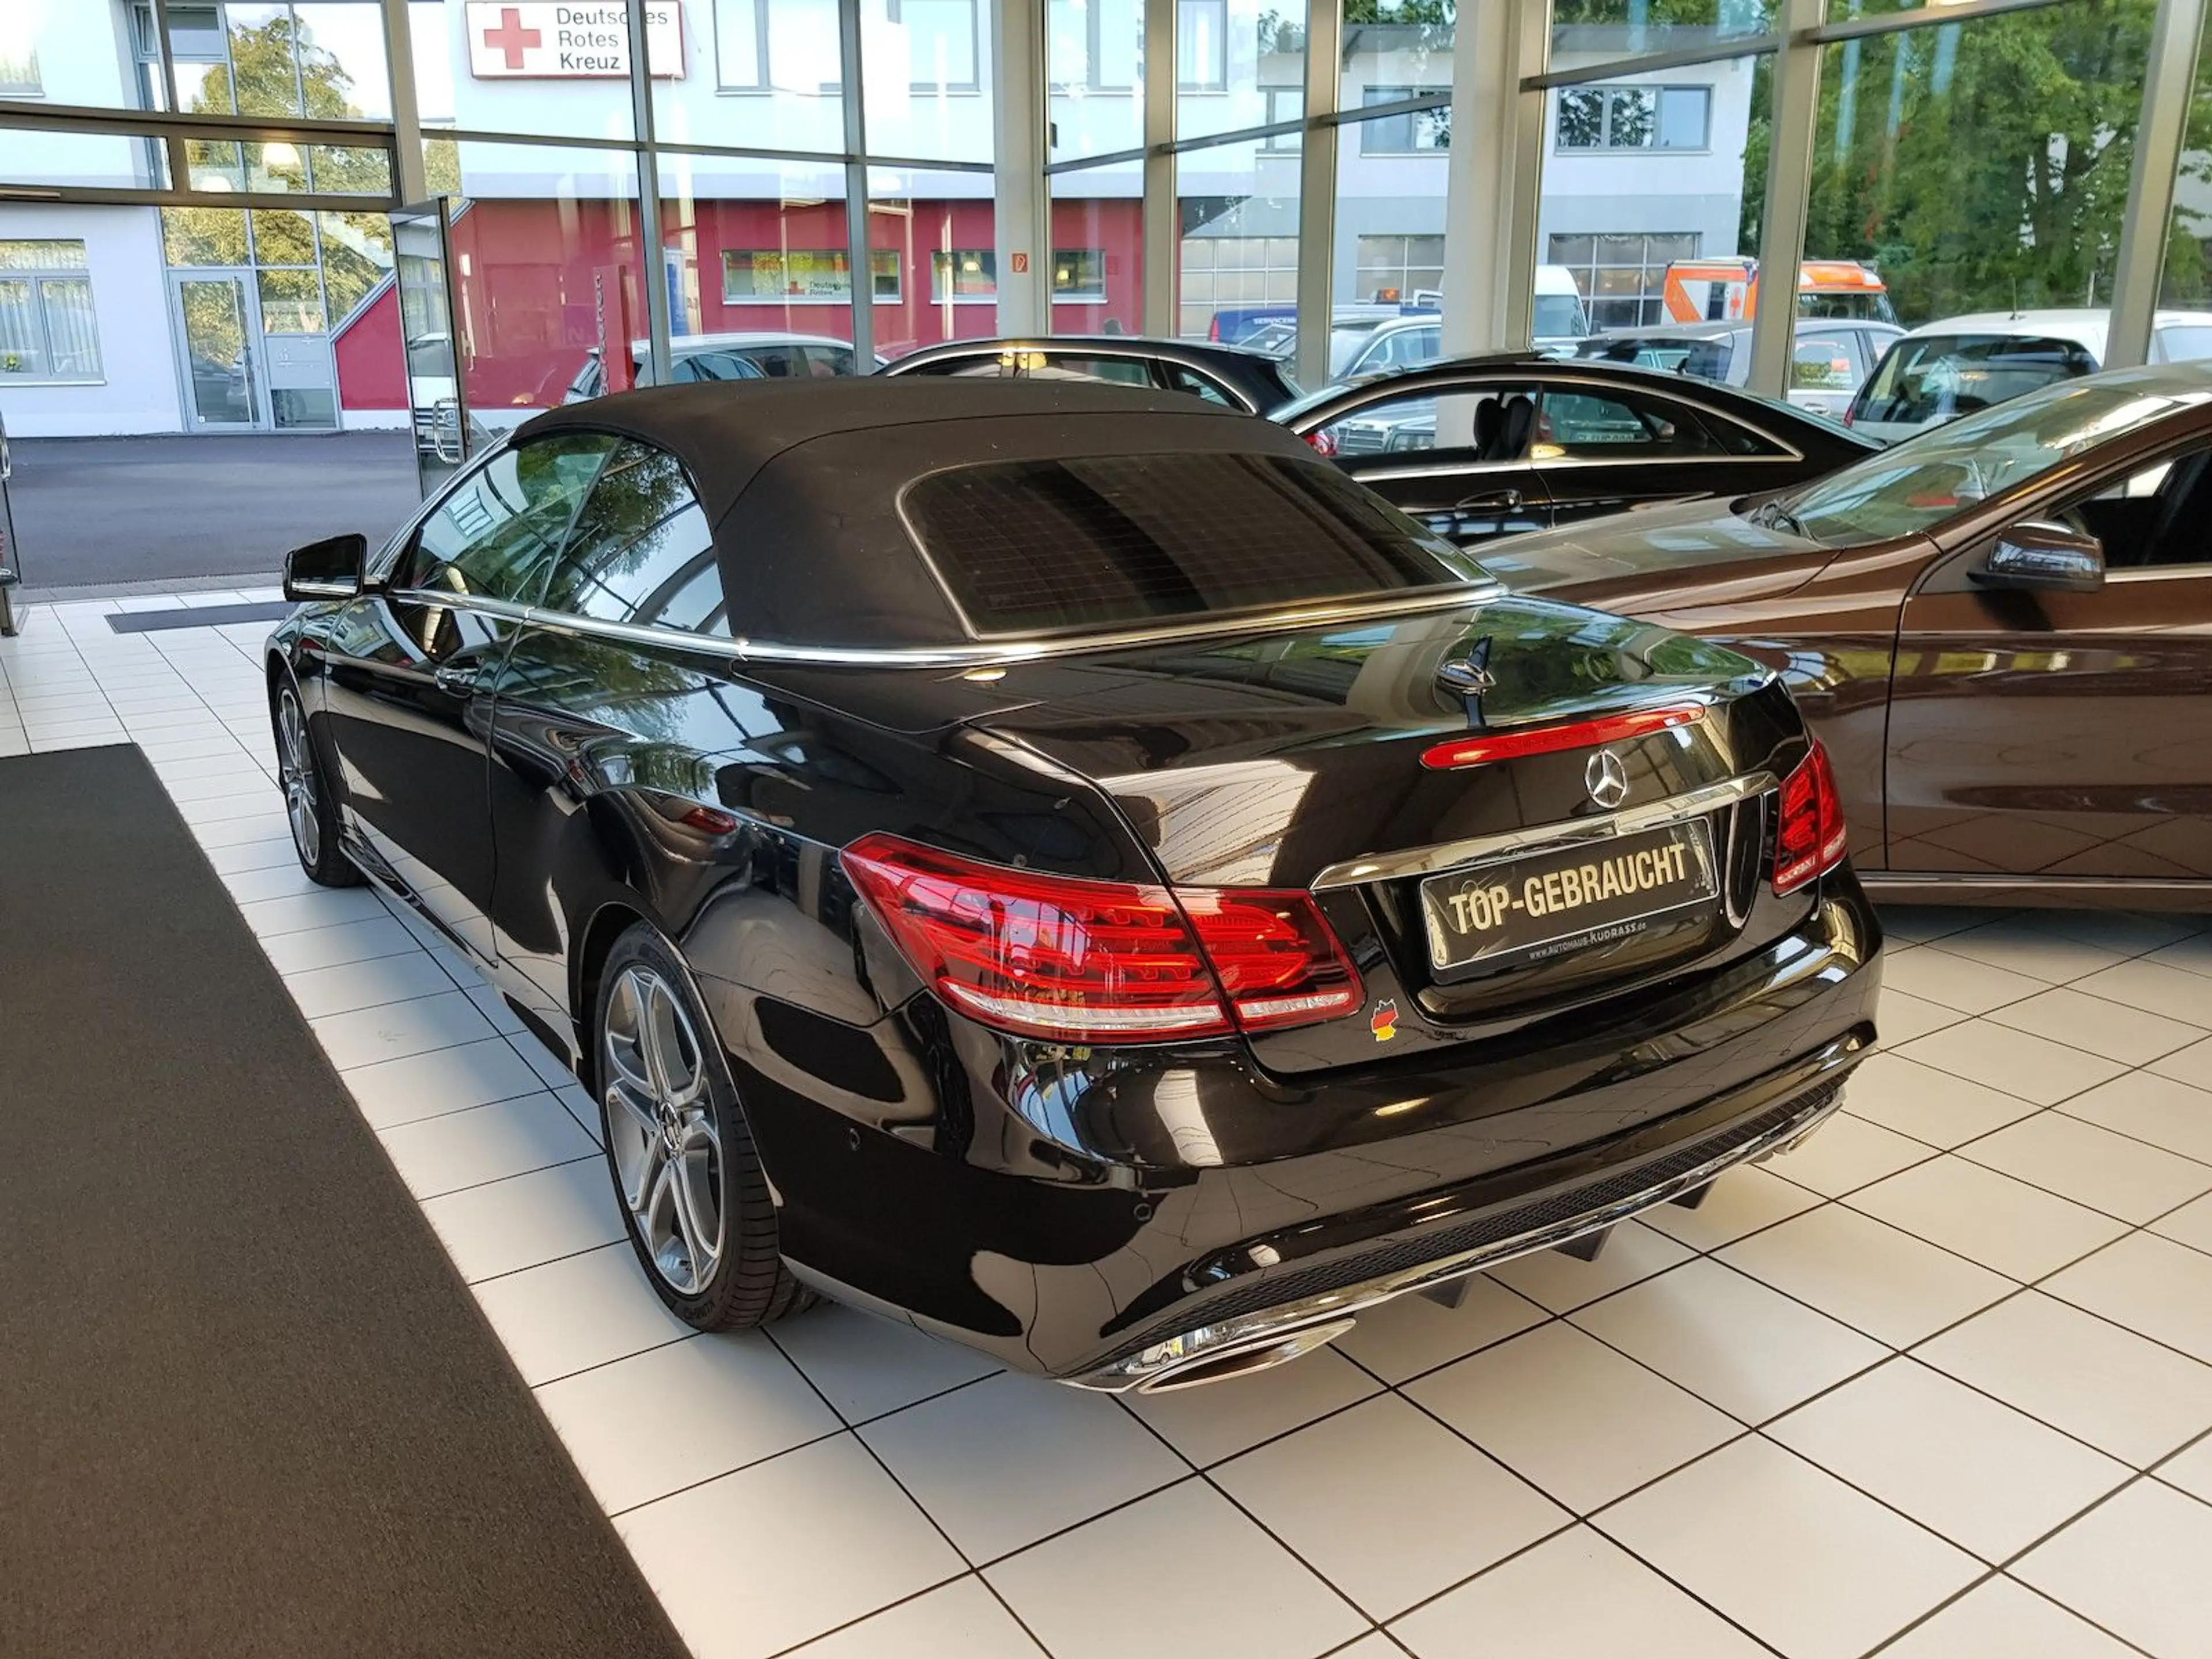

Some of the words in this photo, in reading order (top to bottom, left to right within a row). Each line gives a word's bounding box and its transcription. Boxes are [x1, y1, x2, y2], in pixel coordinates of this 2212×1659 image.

[556, 7, 668, 25] Deutsces
[558, 30, 619, 47] Rotes
[560, 52, 620, 70] Kreuz
[1449, 843, 1685, 935] TOP-GEBRAUCHT
